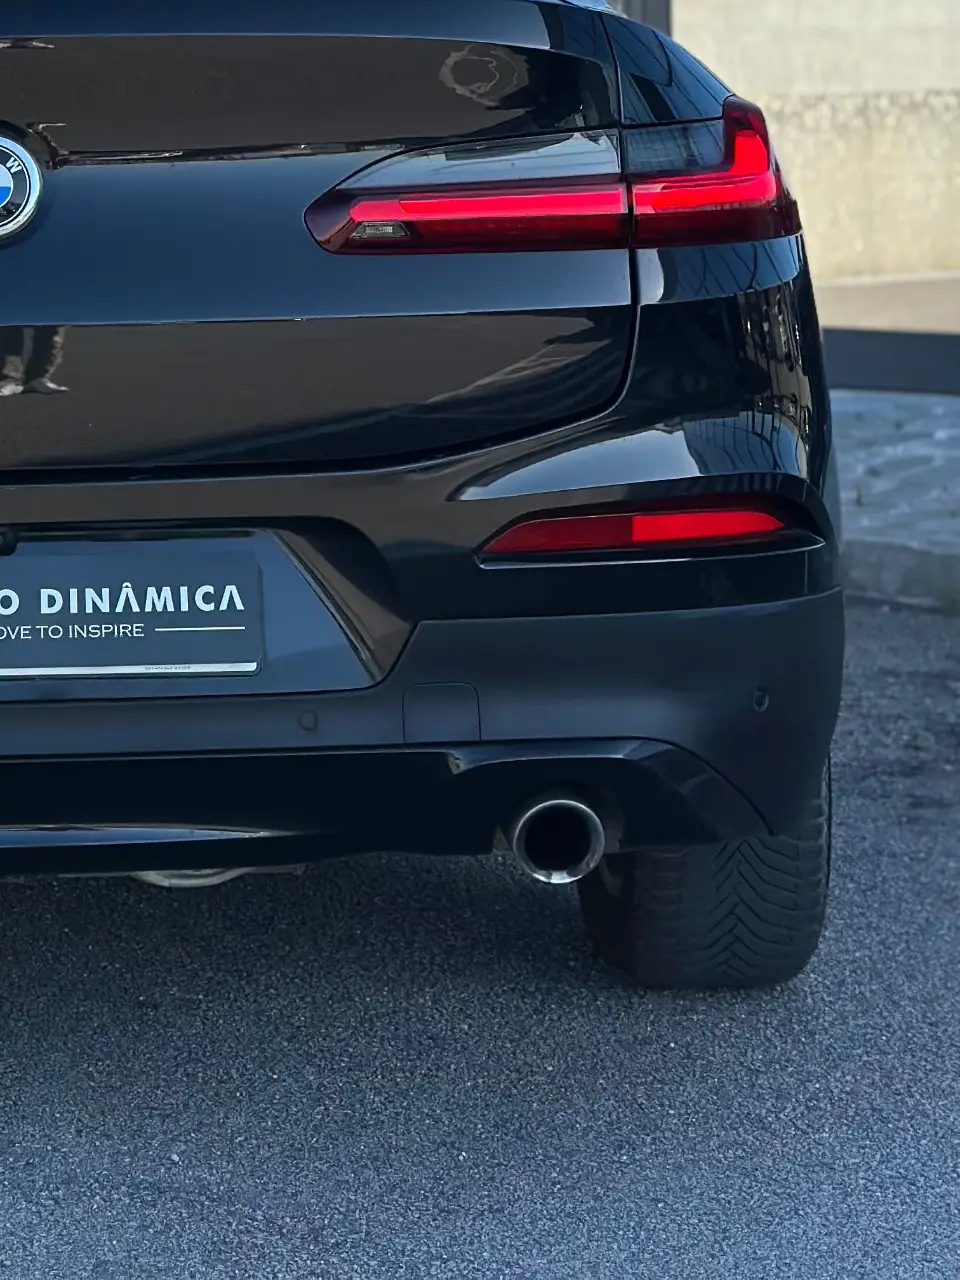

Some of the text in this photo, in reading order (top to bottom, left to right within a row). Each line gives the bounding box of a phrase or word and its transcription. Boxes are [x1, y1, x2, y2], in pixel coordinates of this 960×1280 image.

[40, 582, 246, 615] DINÂMICA
[36, 624, 64, 639] TO
[68, 623, 146, 639] INSPIRE
